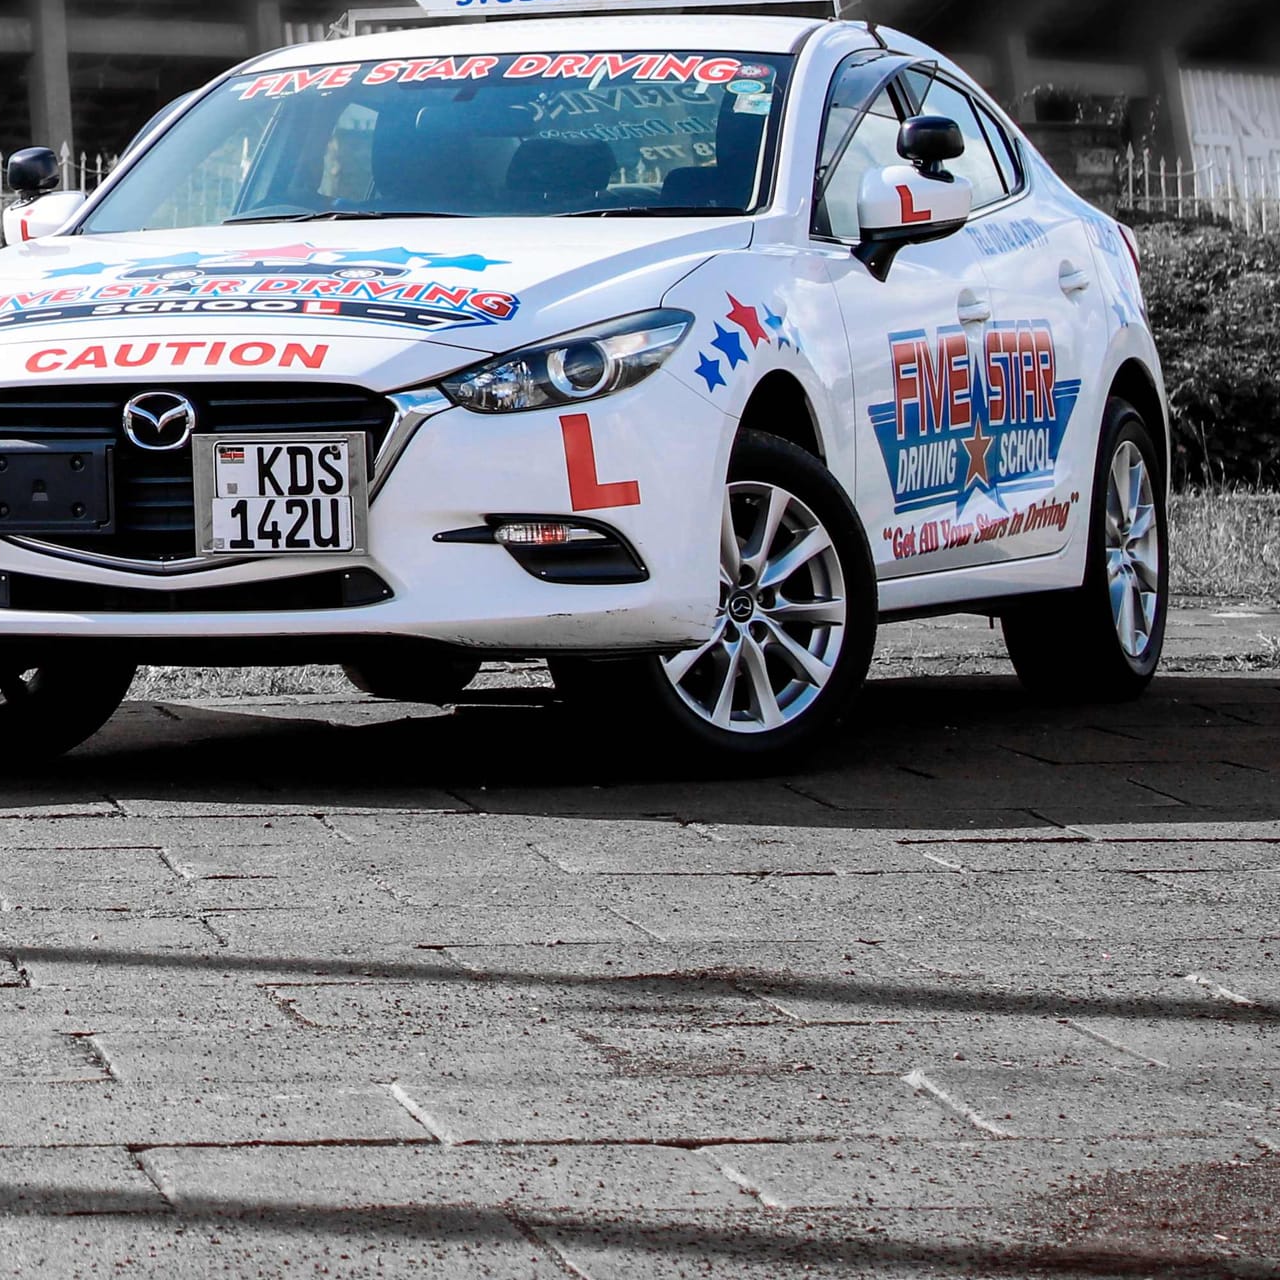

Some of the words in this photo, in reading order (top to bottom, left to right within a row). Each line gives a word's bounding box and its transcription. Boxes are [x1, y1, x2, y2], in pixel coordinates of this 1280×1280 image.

[238, 63, 361, 100] FIVE
[362, 55, 499, 85] STAR
[503, 53, 741, 84] DRIVING
[896, 185, 931, 224] L
[92, 299, 338, 316] SCHOOL
[250, 278, 521, 320] DRIVING
[25, 341, 328, 373] CAUTION
[890, 330, 972, 441] FIVE
[985, 324, 1056, 426] STAR
[257, 446, 344, 496] KDS
[559, 413, 641, 512] L
[896, 439, 957, 495] DRIVING
[999, 428, 1054, 477] SCHOOL
[230, 498, 339, 549] 142U
[918, 521, 939, 554] All
[940, 519, 975, 550] Your
